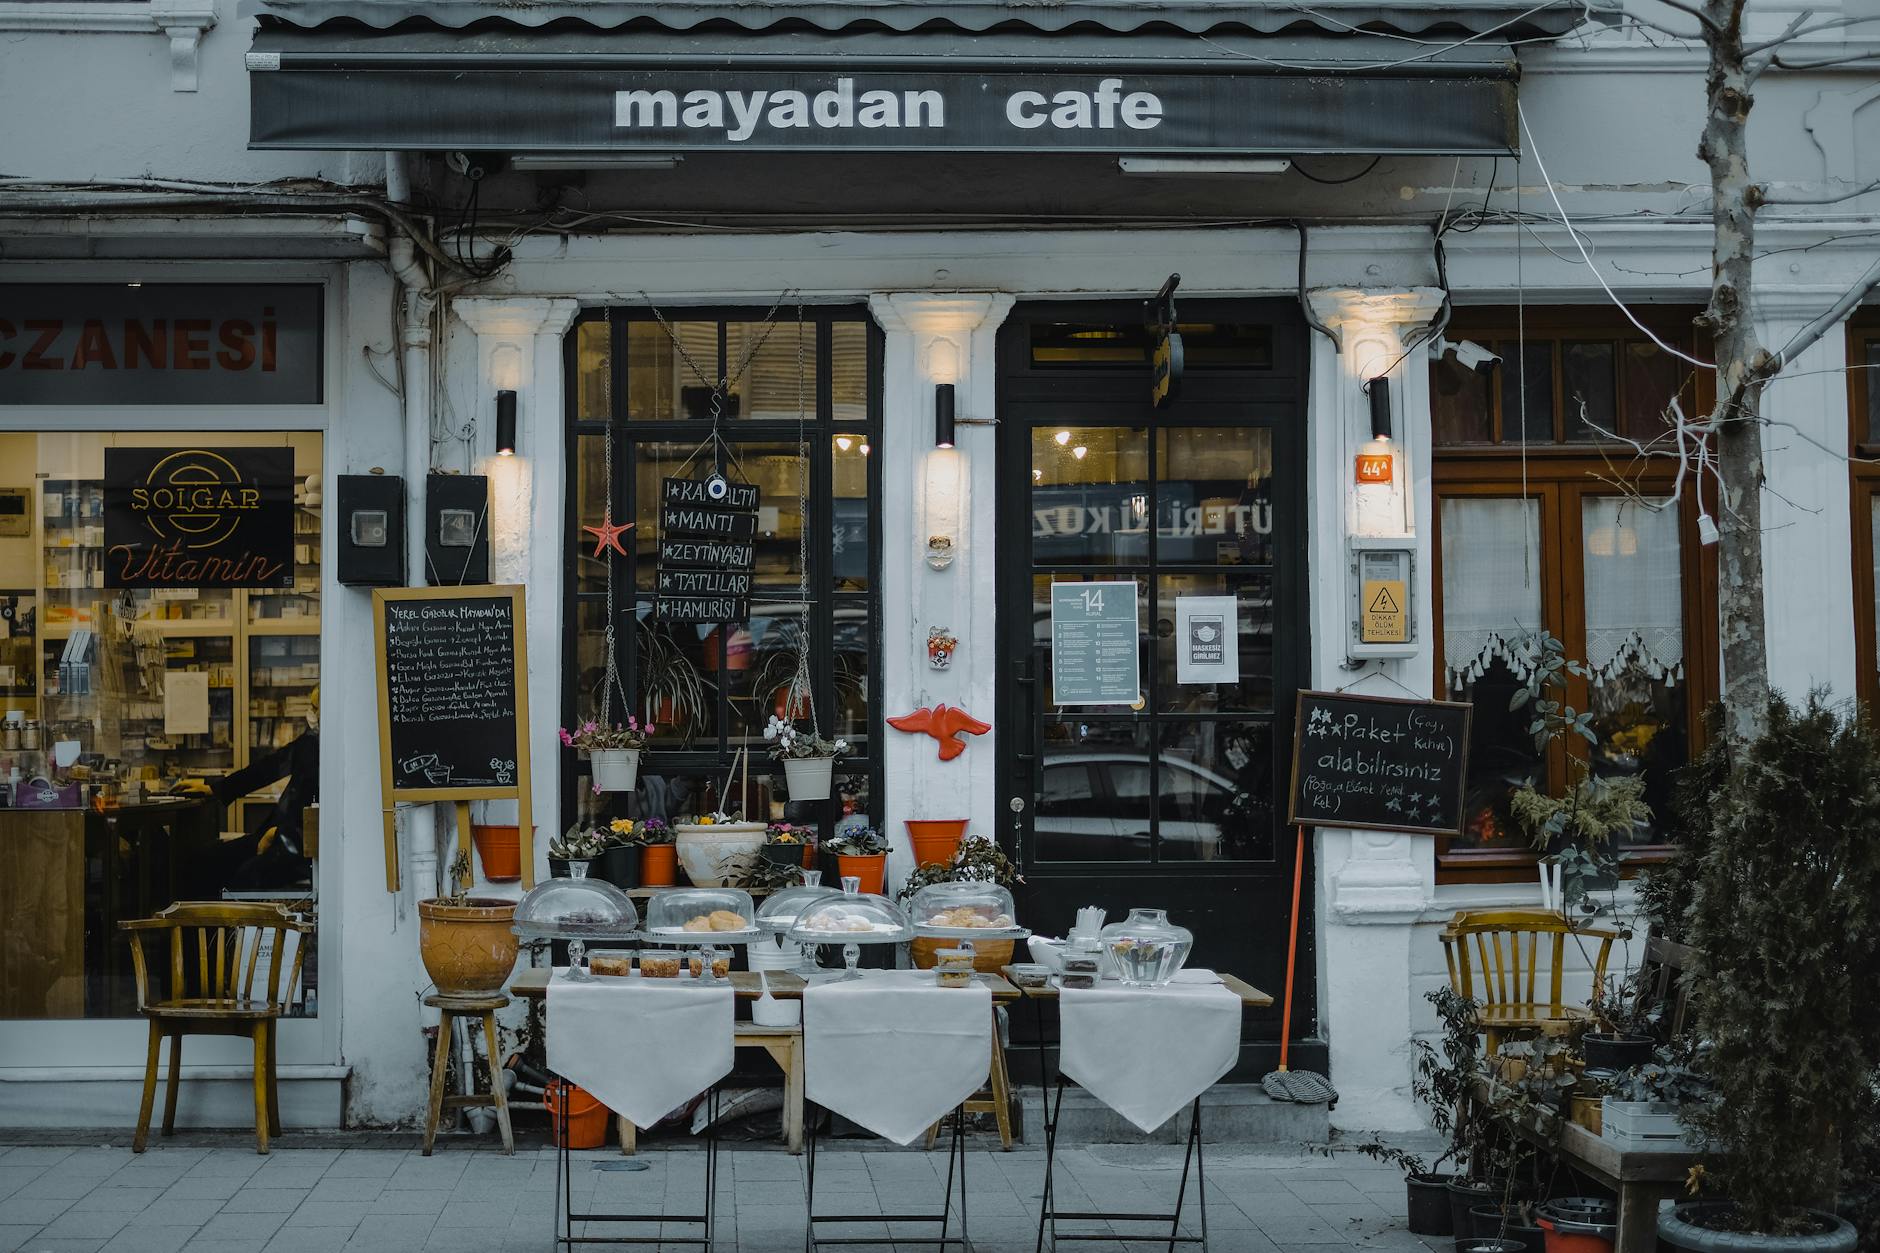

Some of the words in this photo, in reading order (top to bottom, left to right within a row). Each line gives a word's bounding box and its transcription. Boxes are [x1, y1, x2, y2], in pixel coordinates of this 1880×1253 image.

[615, 78, 944, 141] mayadan
[1006, 78, 1163, 129] cafe
[132, 488, 260, 511] SOLGAR
[680, 482, 752, 506] KAALTI
[678, 511, 734, 531] MANTI
[108, 538, 284, 581] Vitamin
[674, 573, 747, 593] TATLILAR
[1080, 589, 1105, 612] 14
[391, 606, 419, 619] YEREL
[1192, 644, 1221, 652] MASKESİZ
[1193, 652, 1221, 660] GİRİLMEZ
[1343, 713, 1406, 743] Paket
[1317, 746, 1442, 781] alabilirsiniz
